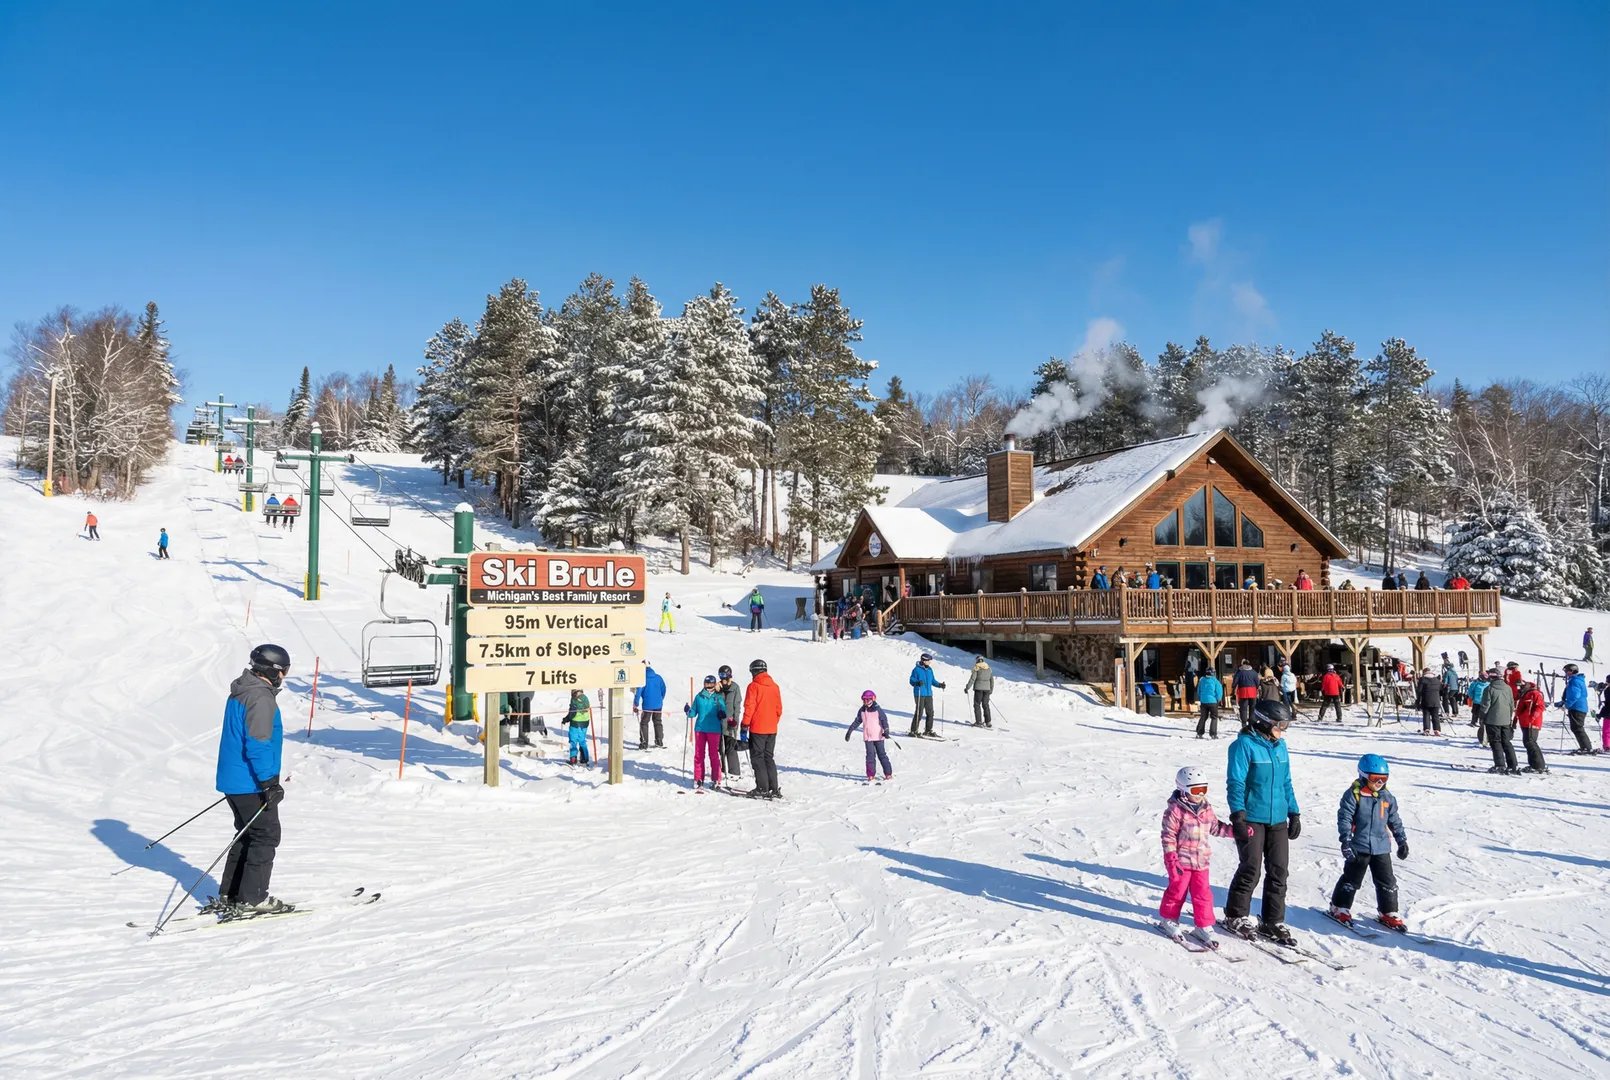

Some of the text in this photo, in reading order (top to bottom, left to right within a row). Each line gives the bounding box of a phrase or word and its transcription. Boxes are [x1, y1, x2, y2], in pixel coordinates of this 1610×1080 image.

[481, 558, 636, 588] Ski Brule
[487, 590, 631, 603] Michigan's Best Family Resort
[504, 614, 608, 629] 95m Vertical
[479, 642, 610, 659] 7.5km of Slopes
[525, 670, 577, 685] 7 Lifts
